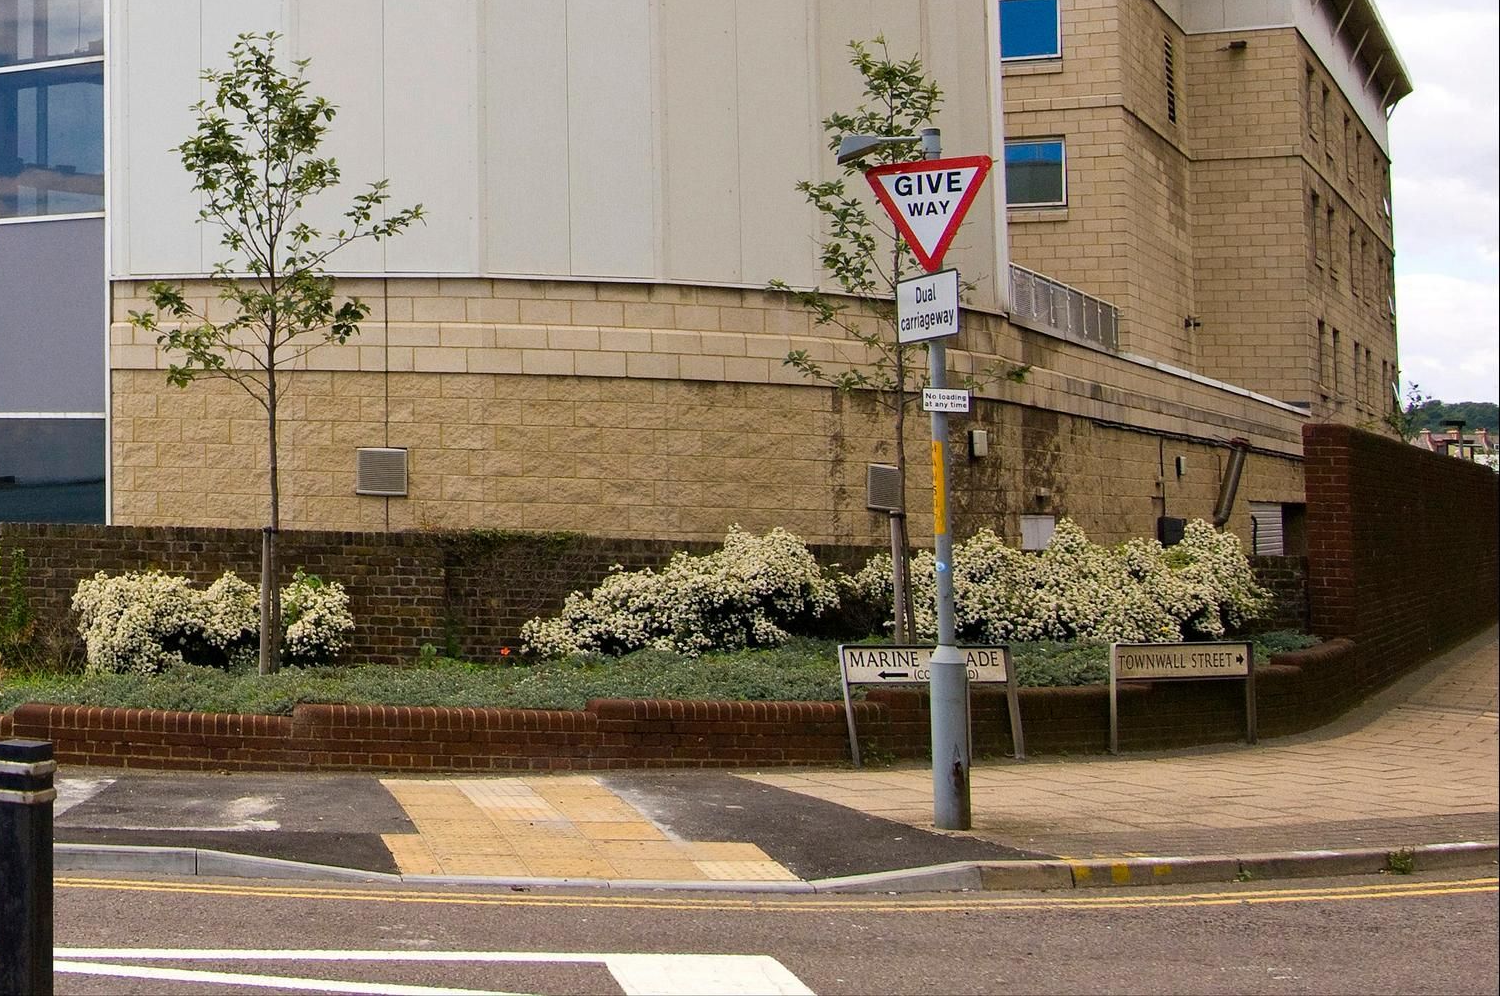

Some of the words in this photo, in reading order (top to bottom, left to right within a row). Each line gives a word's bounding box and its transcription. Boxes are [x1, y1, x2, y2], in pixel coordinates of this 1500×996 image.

[894, 171, 963, 197] GIVE
[907, 200, 950, 217] WAY
[915, 282, 937, 304] Dual
[900, 308, 955, 332] carriageway
[925, 392, 937, 400] No
[938, 393, 967, 402] loading
[934, 401, 949, 409] any
[950, 401, 967, 409] time
[850, 651, 920, 668] MARINE
[929, 651, 1000, 667] ADE
[1118, 653, 1186, 671] TOWNWALL
[1191, 652, 1233, 668] STREET
